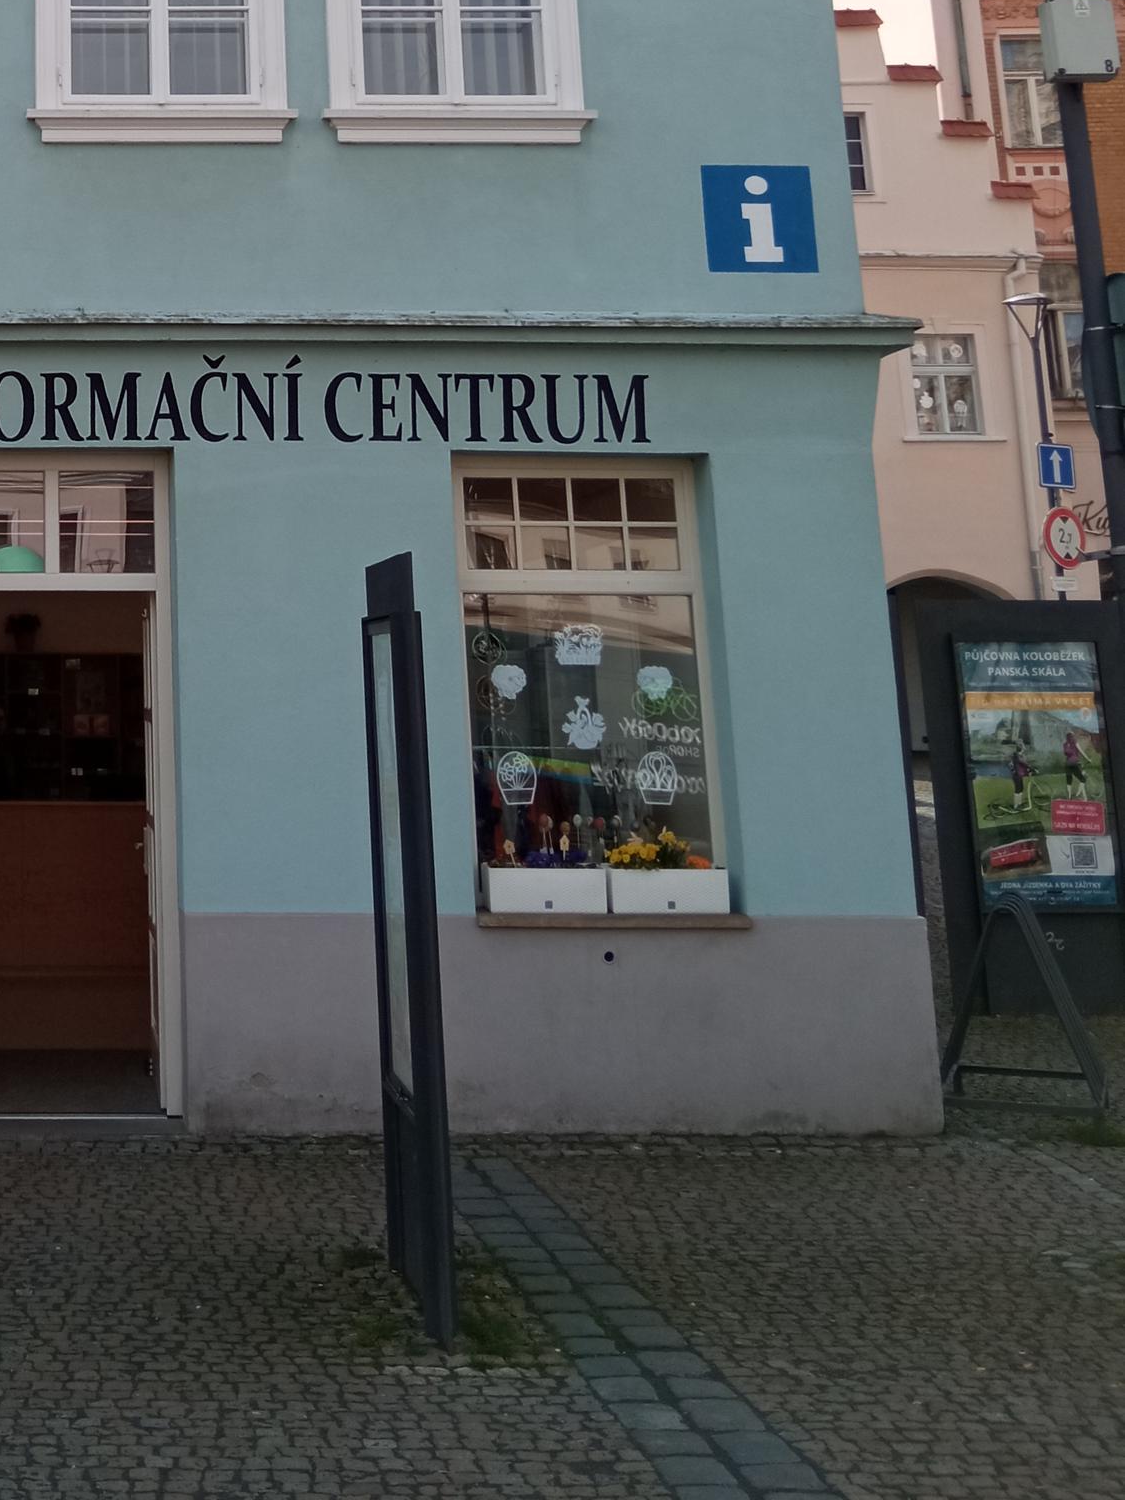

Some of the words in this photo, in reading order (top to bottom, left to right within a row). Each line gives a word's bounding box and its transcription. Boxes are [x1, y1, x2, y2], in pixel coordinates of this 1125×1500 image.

[1105, 59, 1113, 72] 8
[323, 372, 652, 445] CENTRUM
[987, 665, 1030, 677] PANSKÁ
[1031, 666, 1066, 677] SKÁLA
